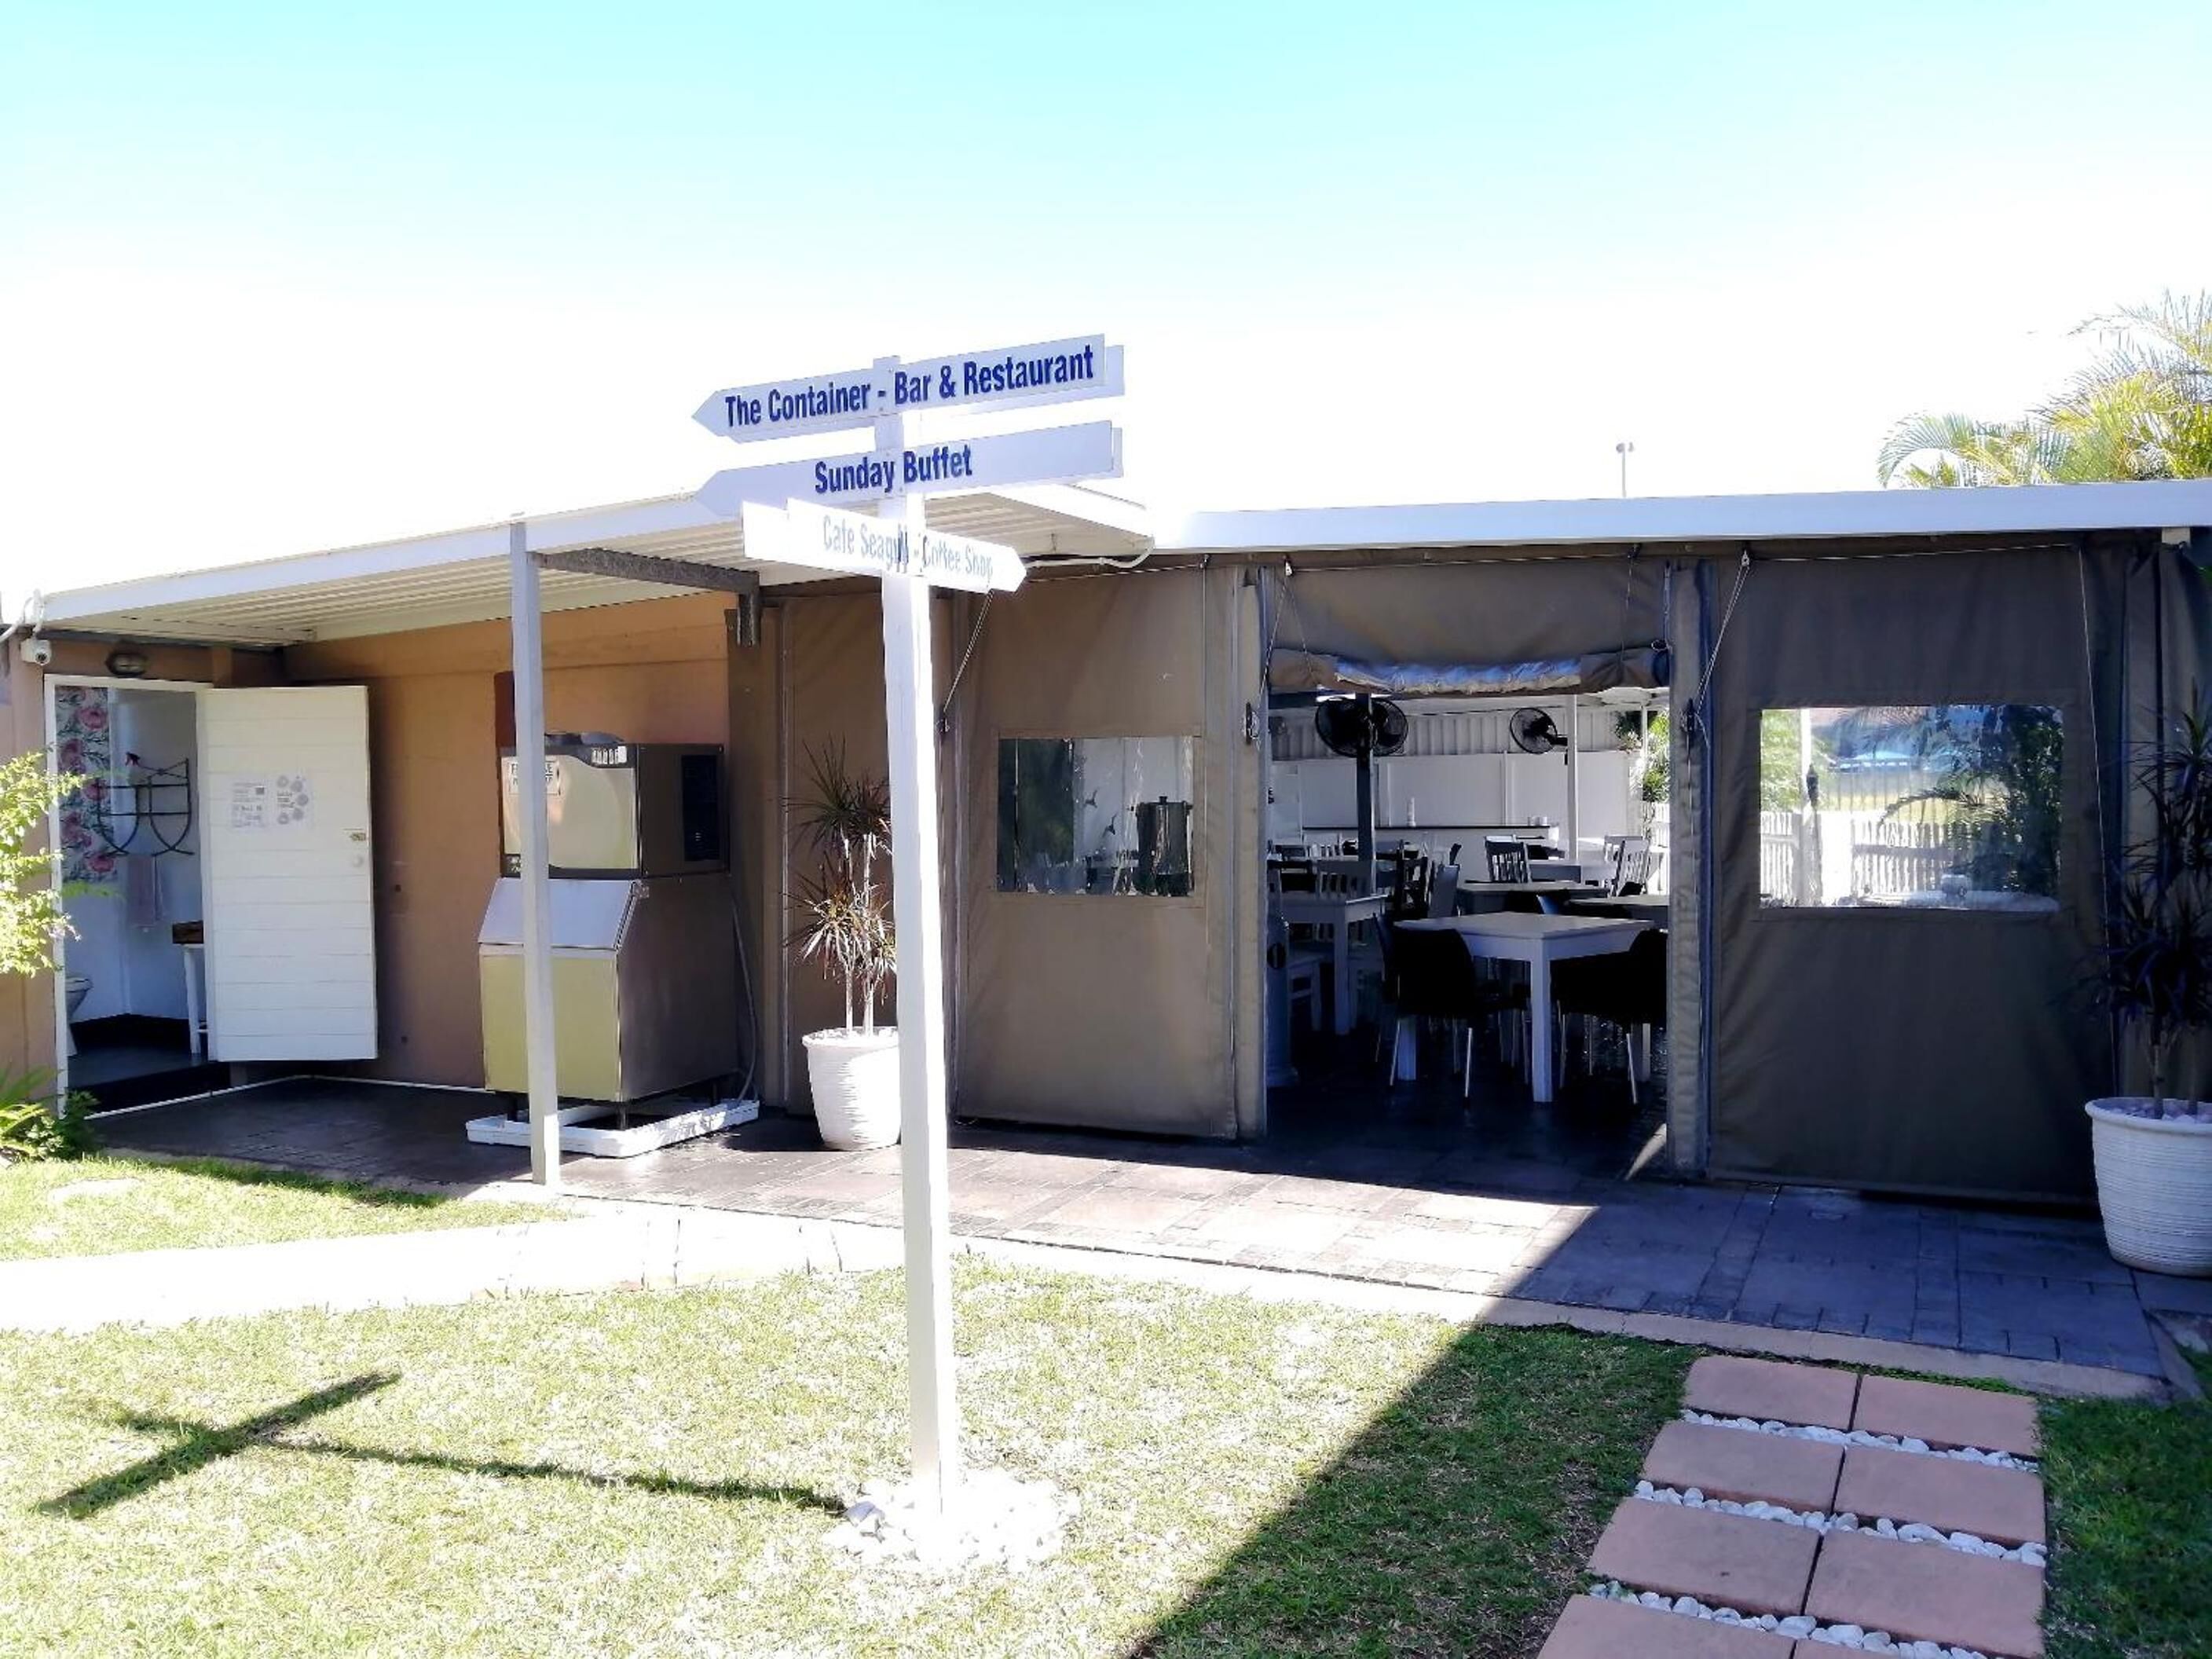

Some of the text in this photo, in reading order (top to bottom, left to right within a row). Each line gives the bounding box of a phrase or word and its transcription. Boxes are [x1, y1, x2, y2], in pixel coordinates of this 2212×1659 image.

[725, 394, 762, 427] The
[767, 381, 870, 423] Container
[894, 371, 932, 405] Bar
[939, 364, 957, 399] &
[963, 344, 1093, 397] Restaurant
[815, 443, 973, 494] Sunday Buffet
[822, 514, 855, 555] Cafe
